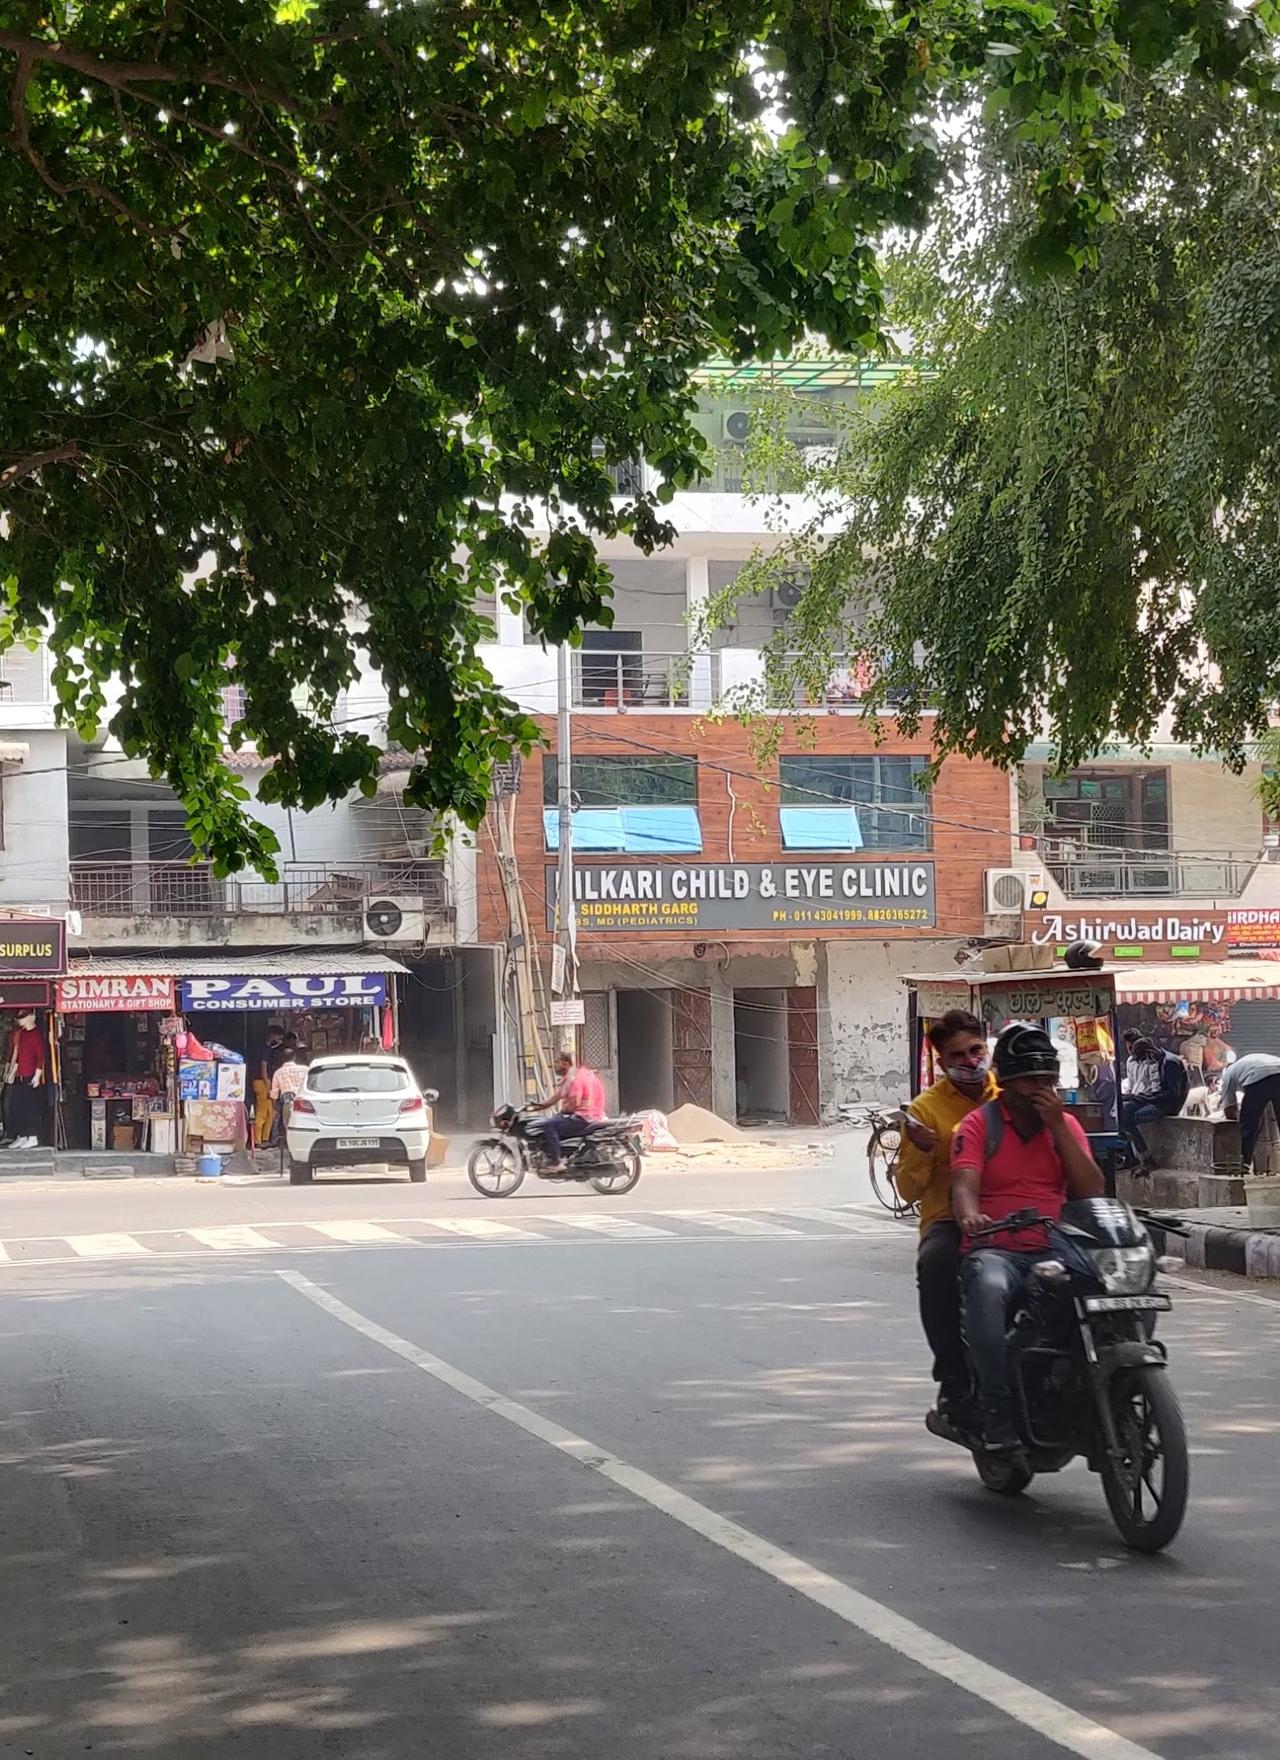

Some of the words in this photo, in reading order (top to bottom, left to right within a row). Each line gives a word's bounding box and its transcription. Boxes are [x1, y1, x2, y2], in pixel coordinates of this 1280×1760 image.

[671, 868, 750, 899] CHILD
[759, 868, 777, 898] &
[785, 868, 834, 898] EYE
[841, 867, 928, 897] CLINIC
[580, 902, 658, 916] SIDDHARTH
[661, 902, 698, 915] GARG
[596, 918, 614, 926] MD
[617, 917, 698, 926] (PEDIATRICS)
[773, 911, 786, 922] PH
[1031, 914, 1163, 945] Ashirwad
[1166, 917, 1224, 944] Dairy
[60, 977, 171, 999] SIMRAN
[185, 976, 382, 999] PAUL
[61, 1000, 116, 1010] STATIONARY
[117, 999, 125, 1009] &
[126, 999, 147, 1009] GIFT
[148, 998, 171, 1009] SHOP
[193, 998, 305, 1010] CONSUMER
[310, 996, 375, 1007] STORE
